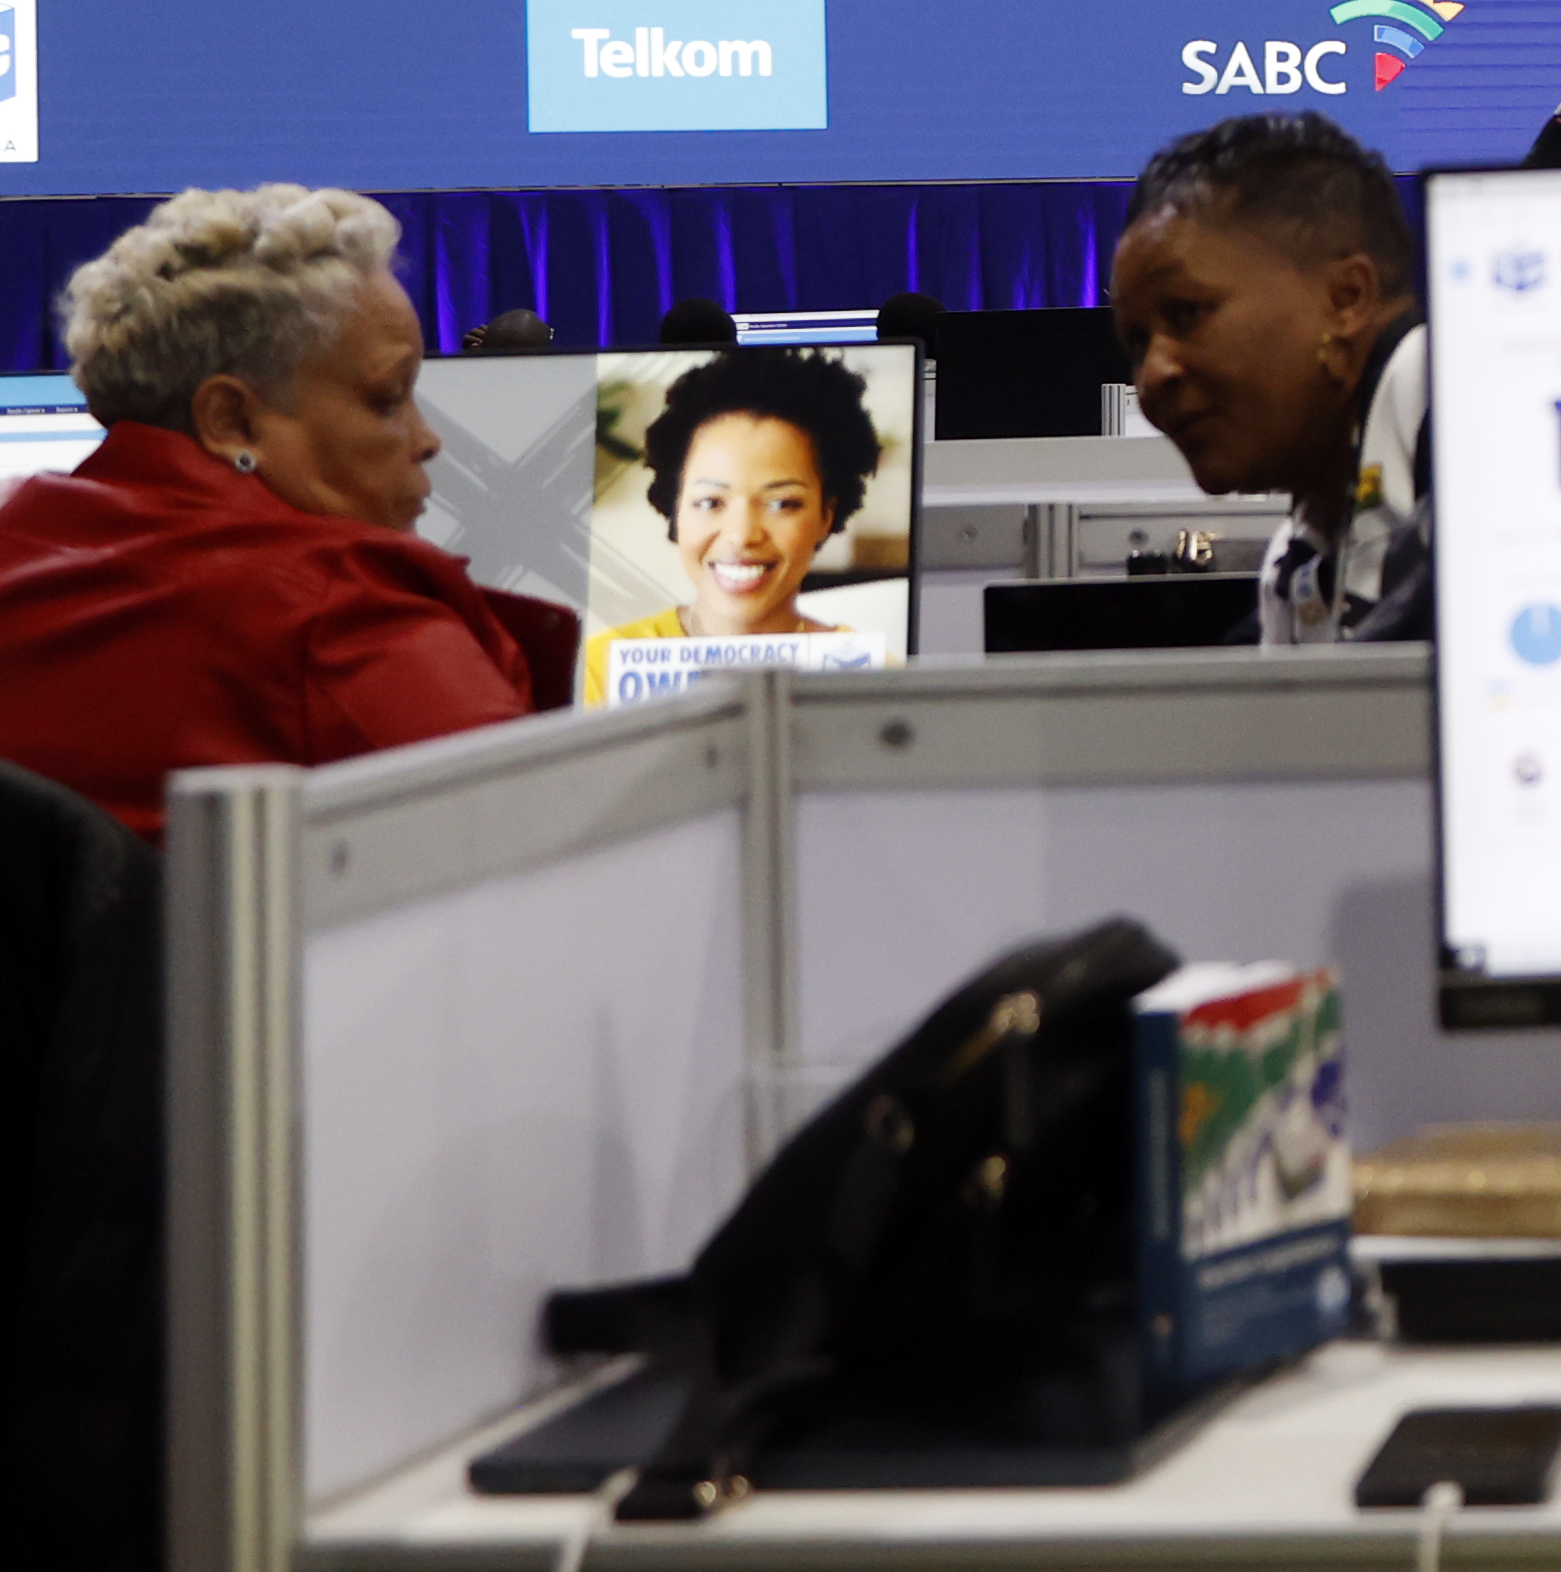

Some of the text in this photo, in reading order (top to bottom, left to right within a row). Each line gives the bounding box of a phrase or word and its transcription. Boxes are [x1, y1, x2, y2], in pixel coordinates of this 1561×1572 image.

[572, 27, 772, 77] Telkom
[1182, 40, 1346, 94] SABC
[619, 642, 800, 665] YOUR DEMOCRACY
[617, 670, 702, 704] OW
